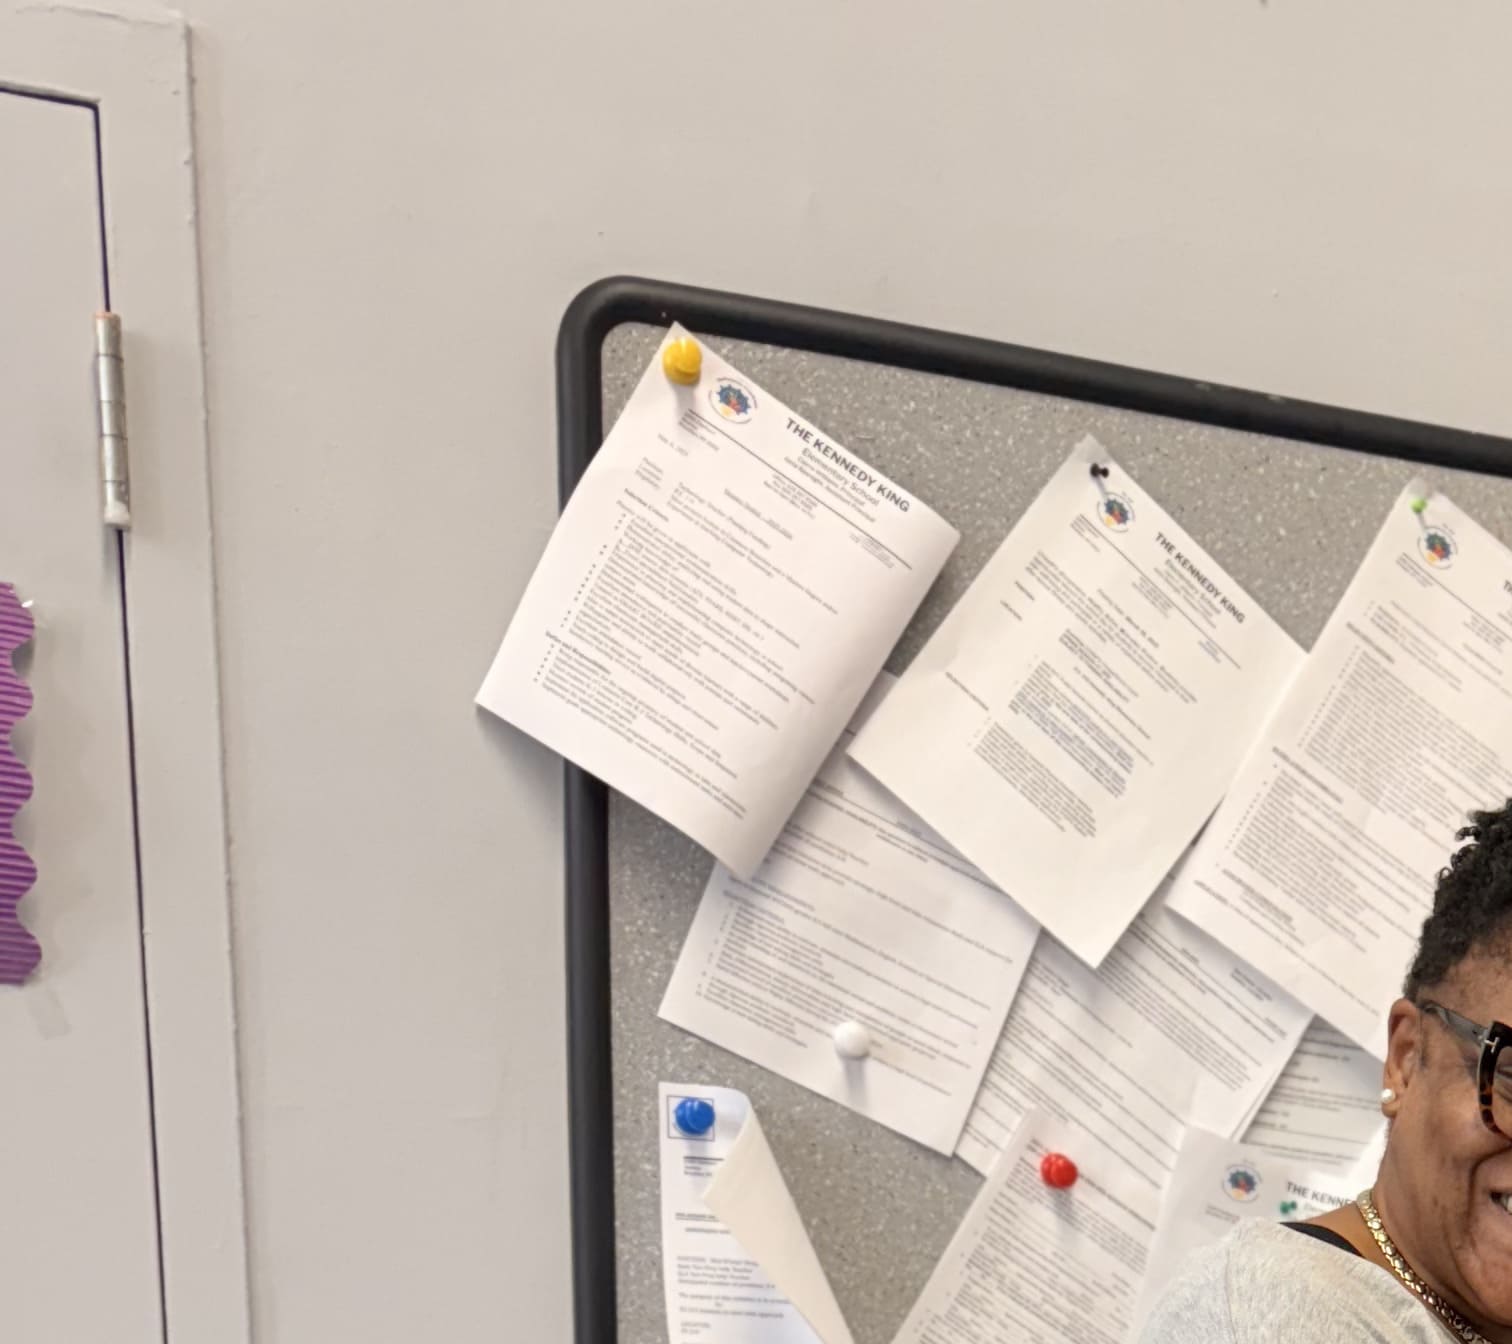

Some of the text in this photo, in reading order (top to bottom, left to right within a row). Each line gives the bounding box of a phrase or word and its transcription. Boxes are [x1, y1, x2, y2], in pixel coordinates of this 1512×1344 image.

[785, 417, 814, 444] THE
[812, 438, 877, 488] KENNEDY
[876, 484, 911, 513] KING
[1155, 531, 1177, 555] THE
[1174, 551, 1222, 598] KENNEDY
[1219, 596, 1246, 624] KING
[1286, 1181, 1309, 1200] THE
